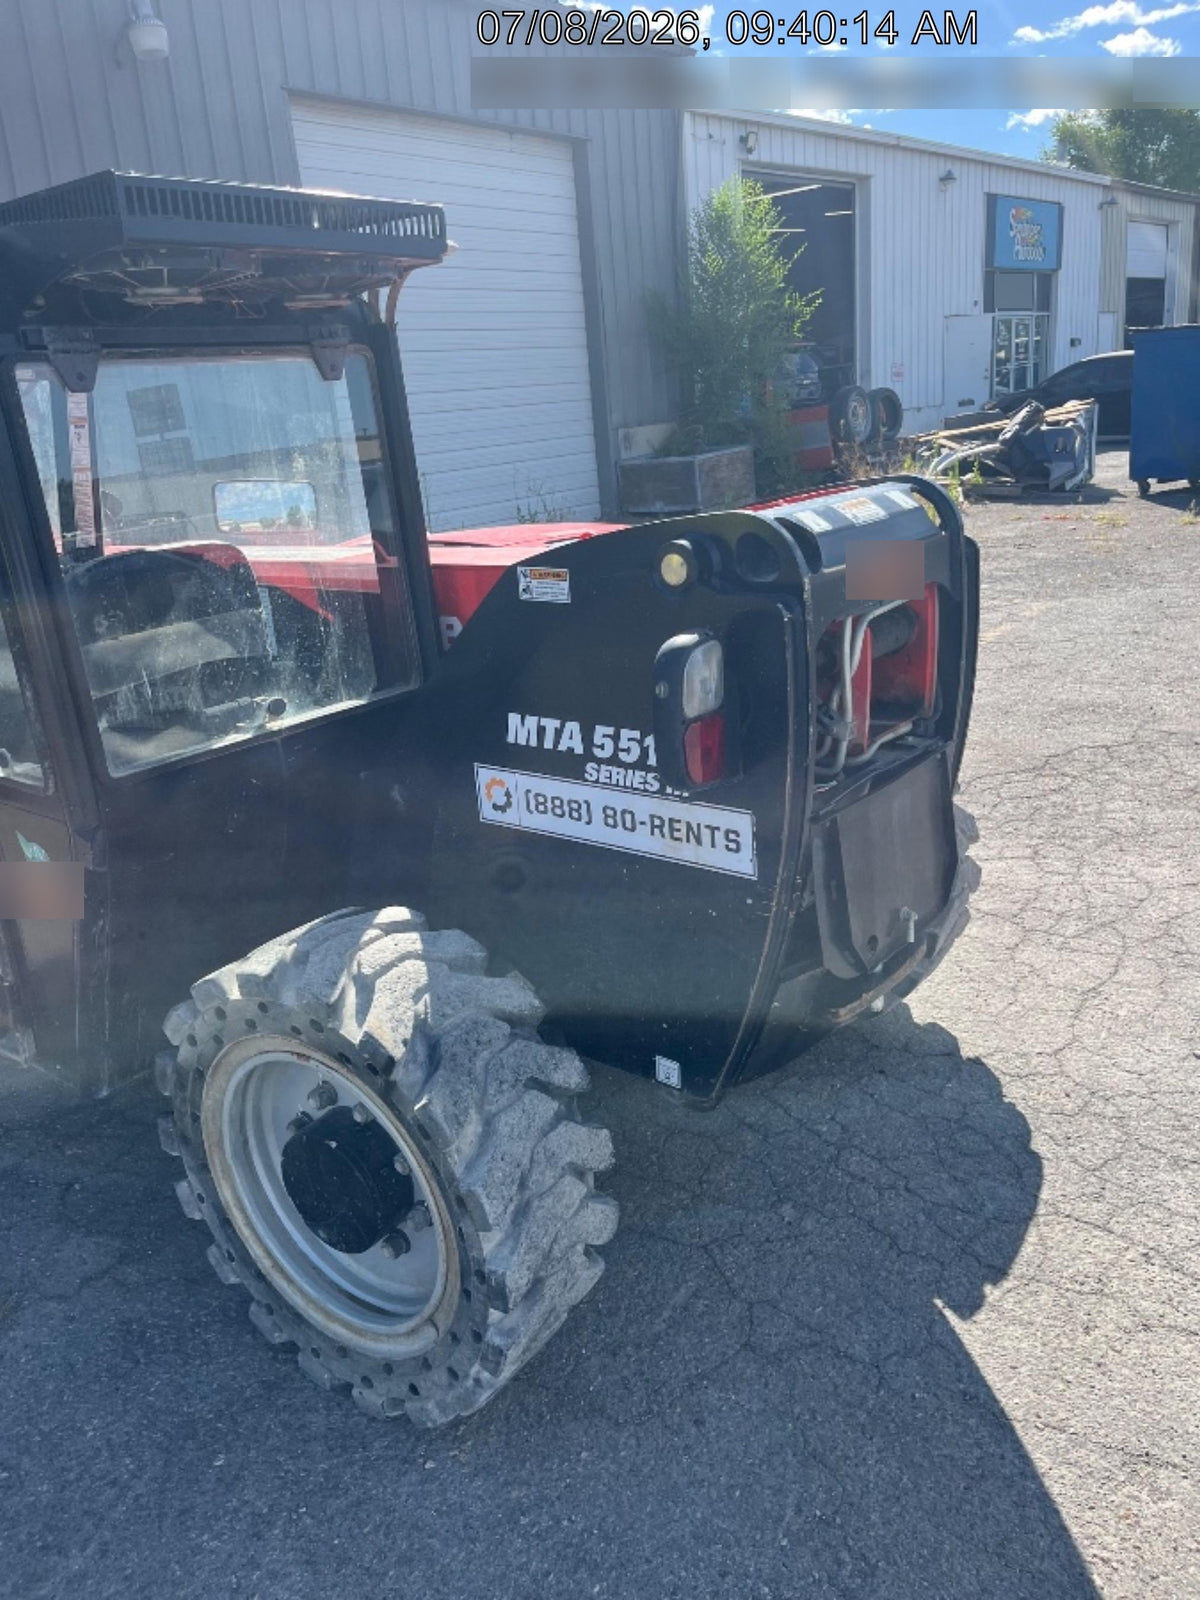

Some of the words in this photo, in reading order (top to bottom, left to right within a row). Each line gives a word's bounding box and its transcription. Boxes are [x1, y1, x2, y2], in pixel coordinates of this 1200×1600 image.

[506, 712, 584, 755] MTA
[584, 762, 660, 793] SERIES
[523, 788, 592, 826] (888)
[602, 805, 742, 854] 80-RENTS
